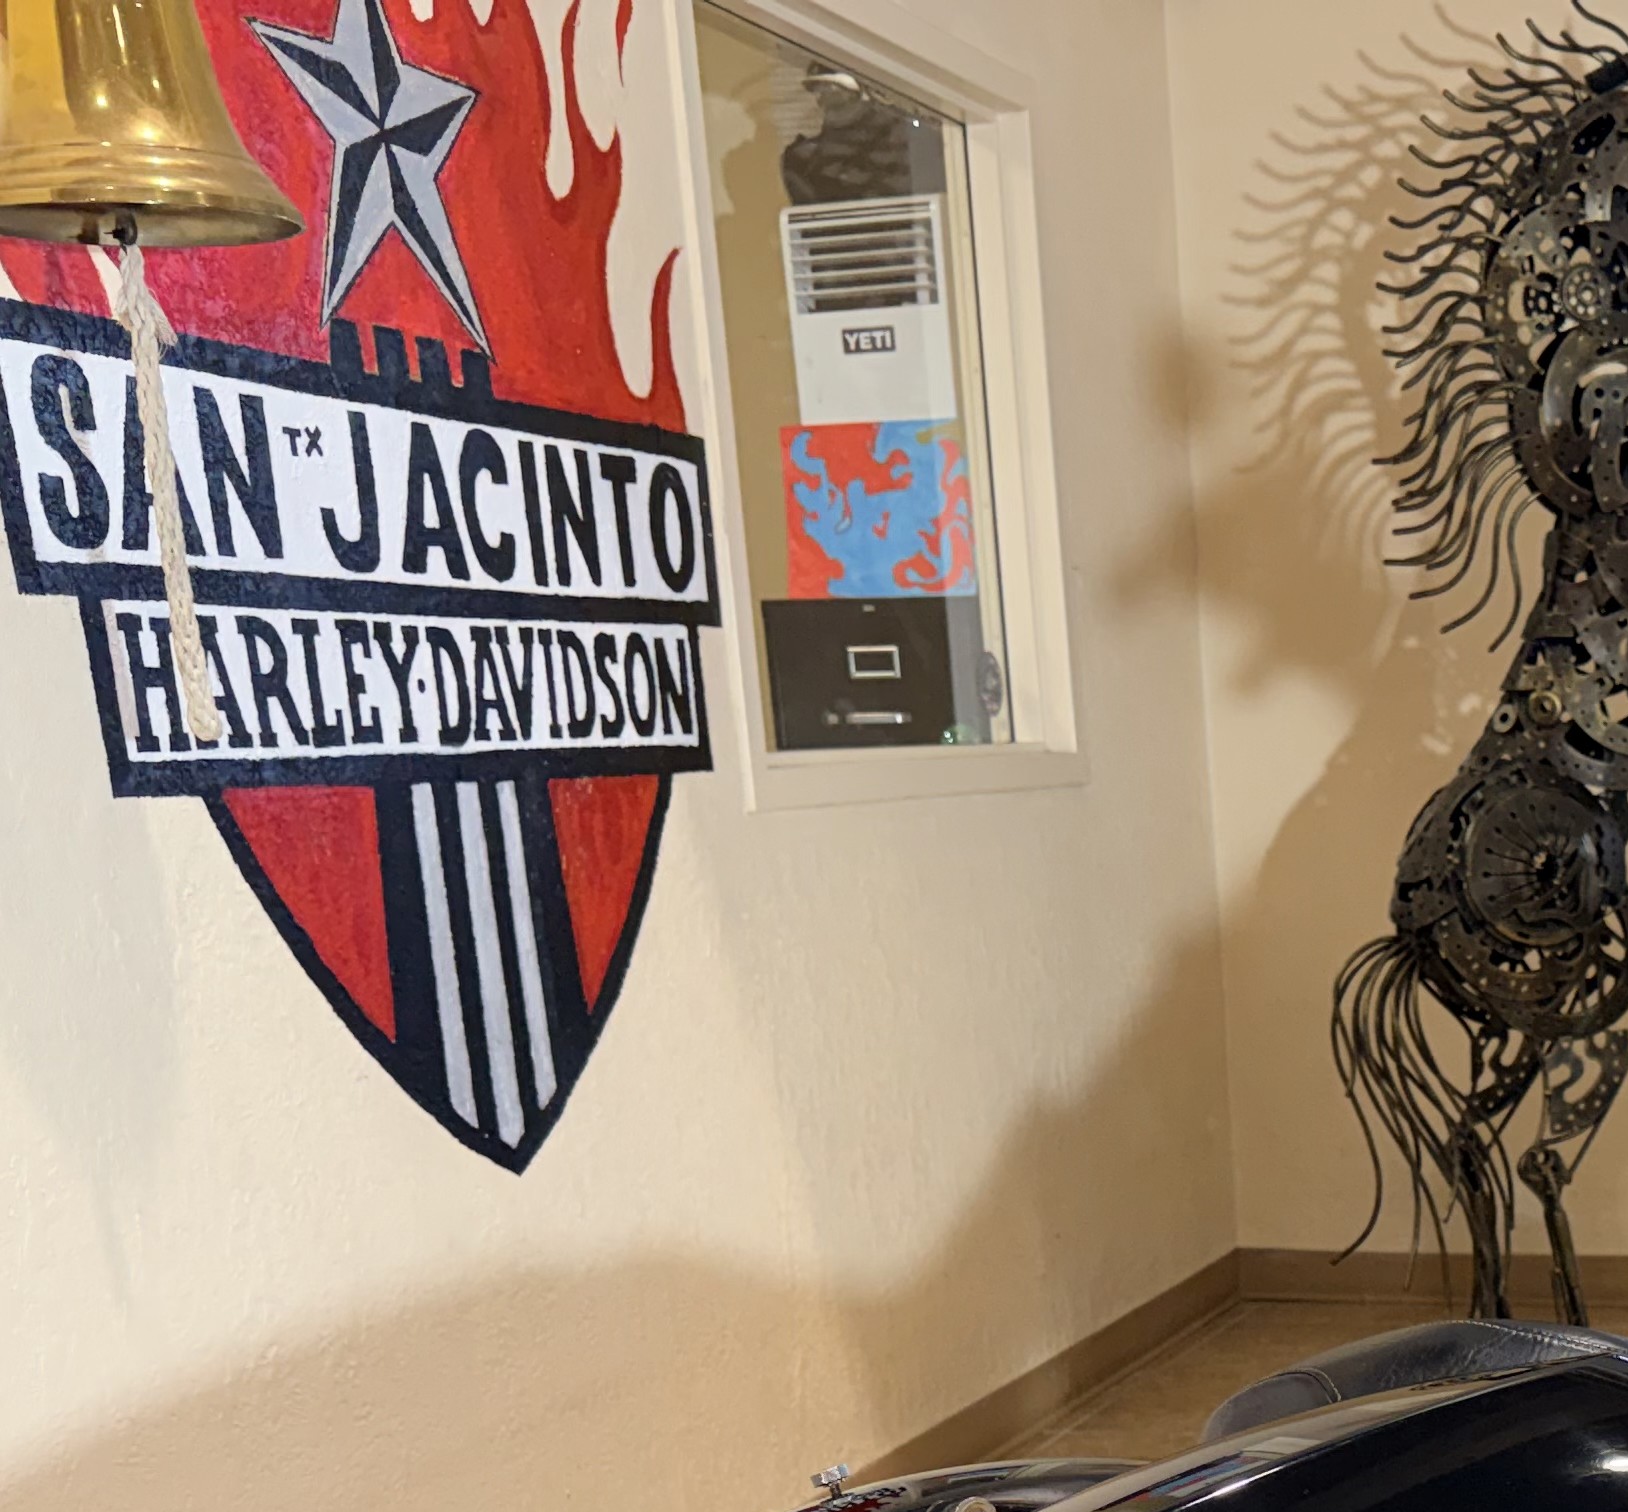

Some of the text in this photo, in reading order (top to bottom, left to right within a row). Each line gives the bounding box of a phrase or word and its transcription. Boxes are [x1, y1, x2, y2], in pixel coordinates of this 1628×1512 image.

[844, 329, 892, 351] YETI
[31, 353, 697, 594] SAN TX JACINTO
